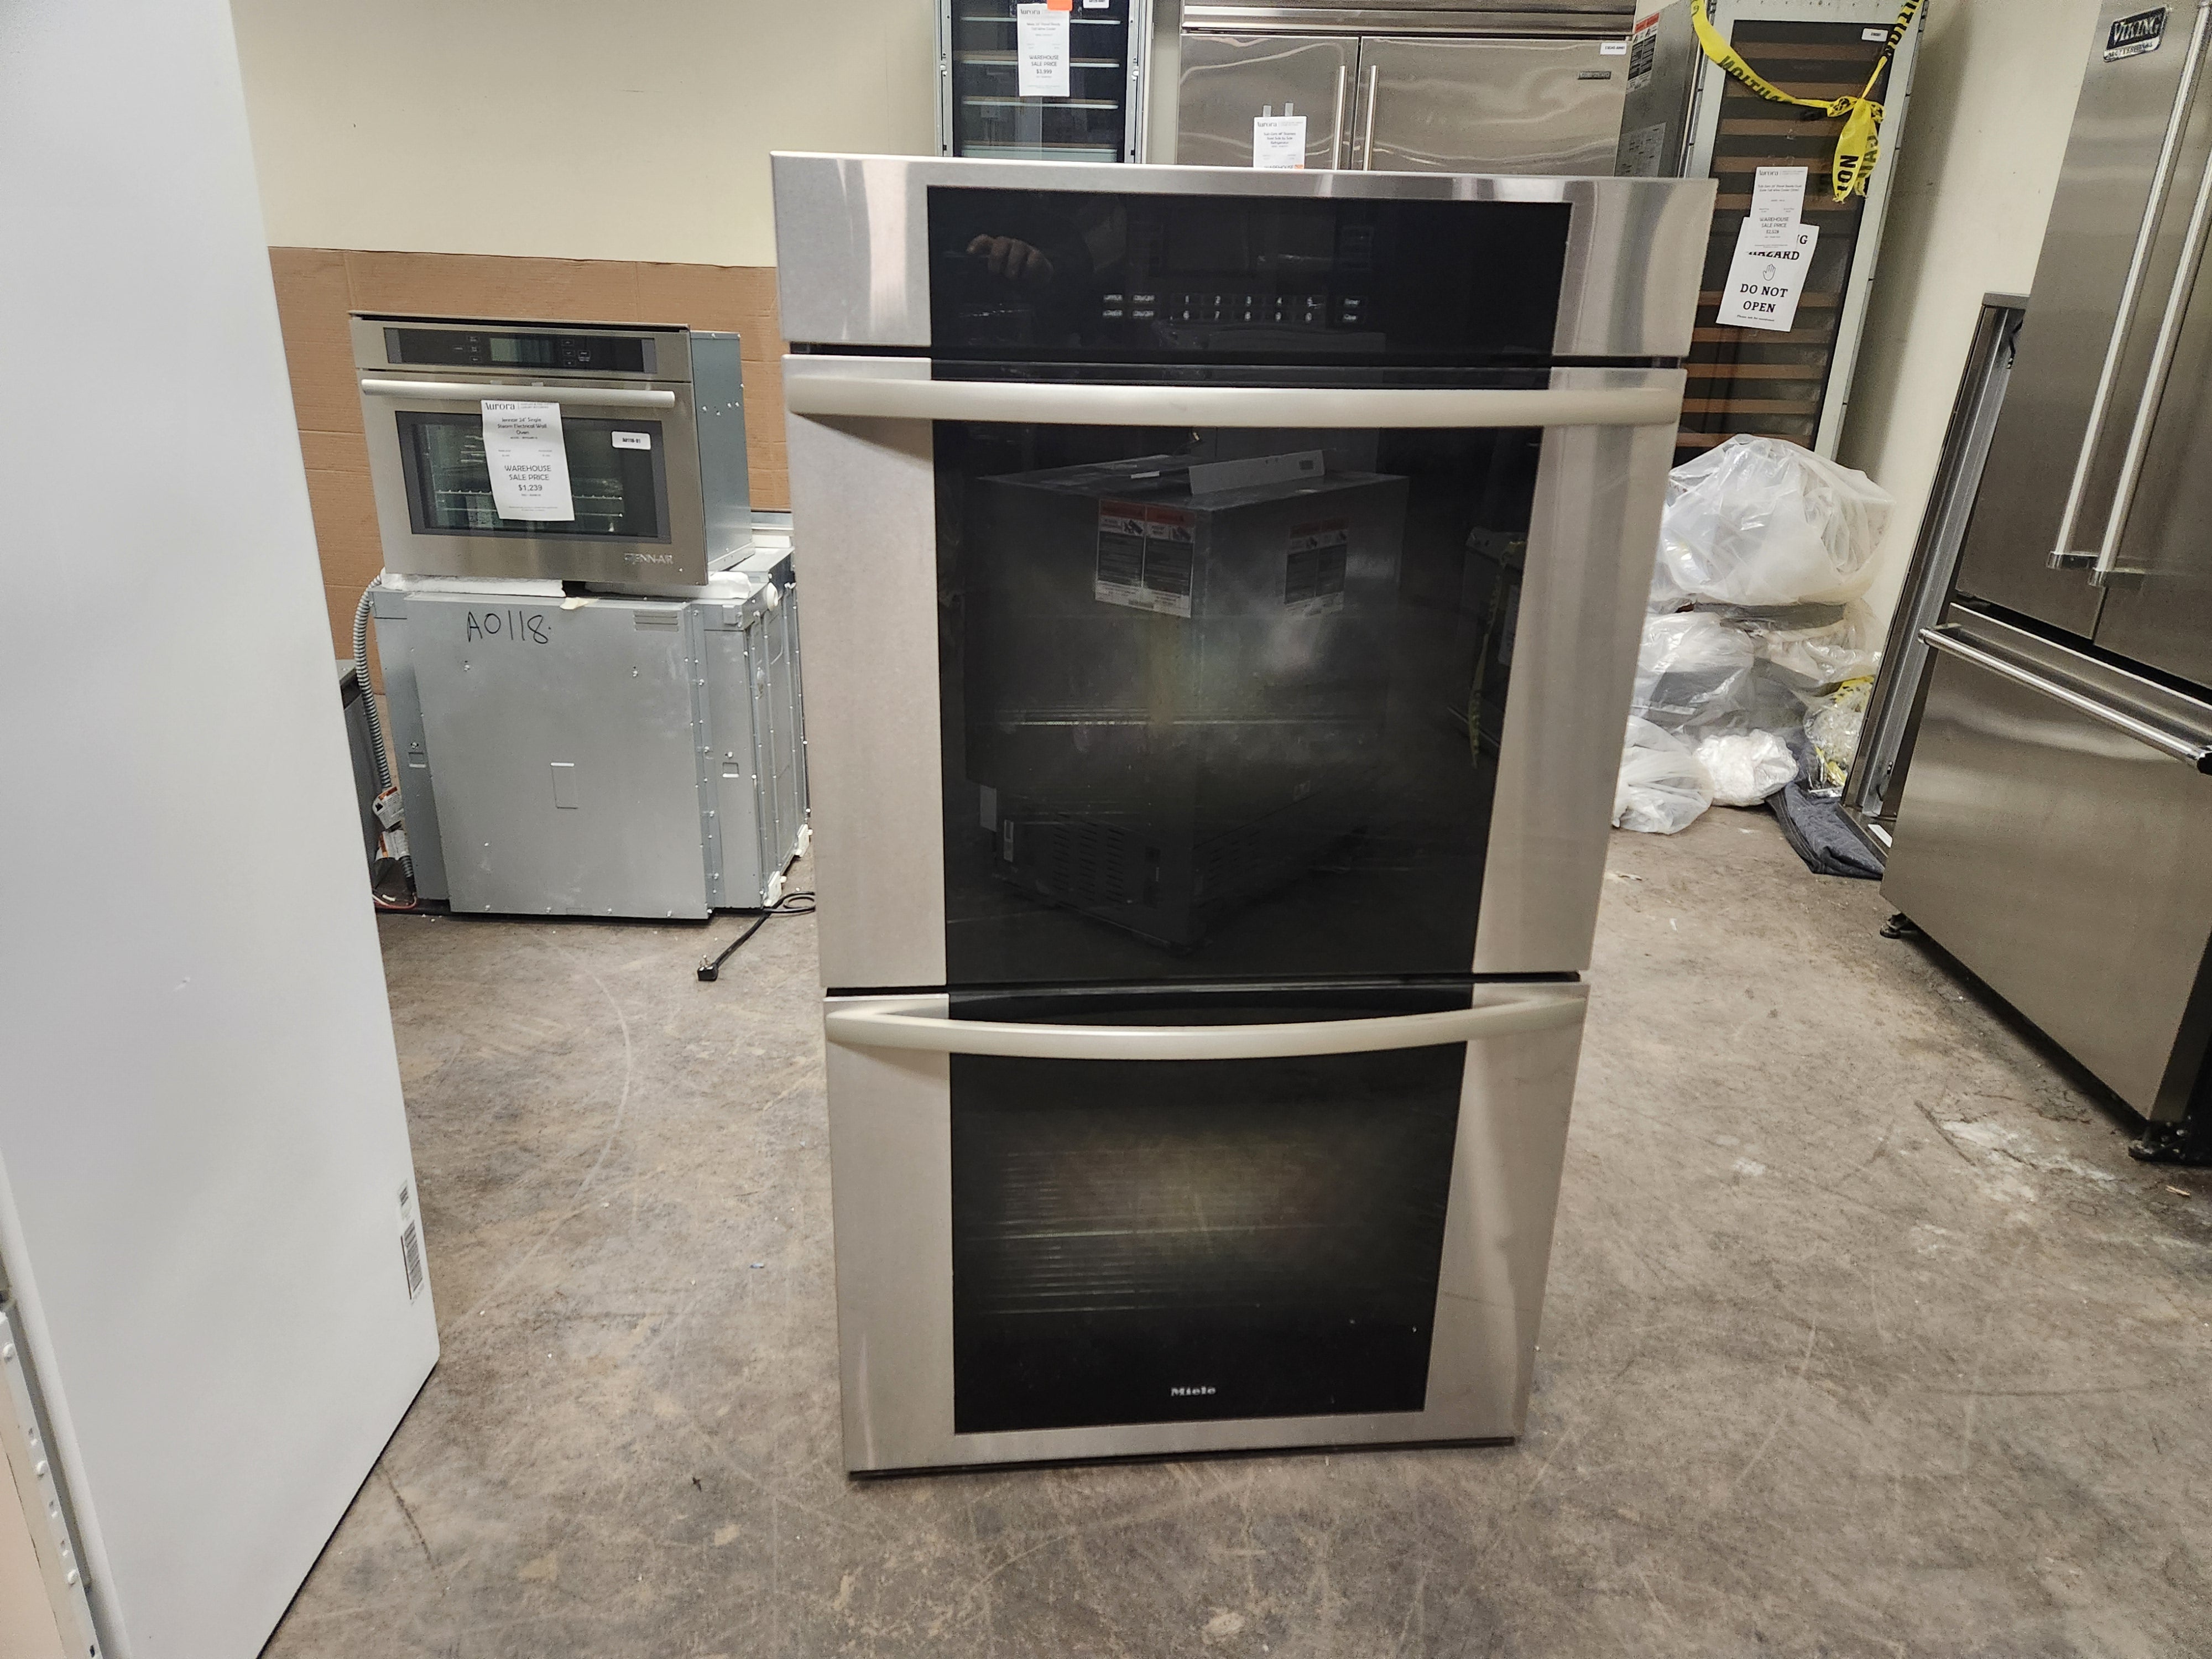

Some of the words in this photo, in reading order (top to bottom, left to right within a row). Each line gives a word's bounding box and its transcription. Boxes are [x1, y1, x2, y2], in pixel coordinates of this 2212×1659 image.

[2114, 13, 2161, 45] VIKING
[1740, 283, 1758, 294] DO
[1761, 286, 1788, 298] NOT
[1214, 295, 1221, 305] 2
[1743, 300, 1776, 313] OPEN
[1214, 311, 1220, 320] 7
[485, 402, 515, 410] Aurora
[1171, 1386, 1216, 1396] Miele
